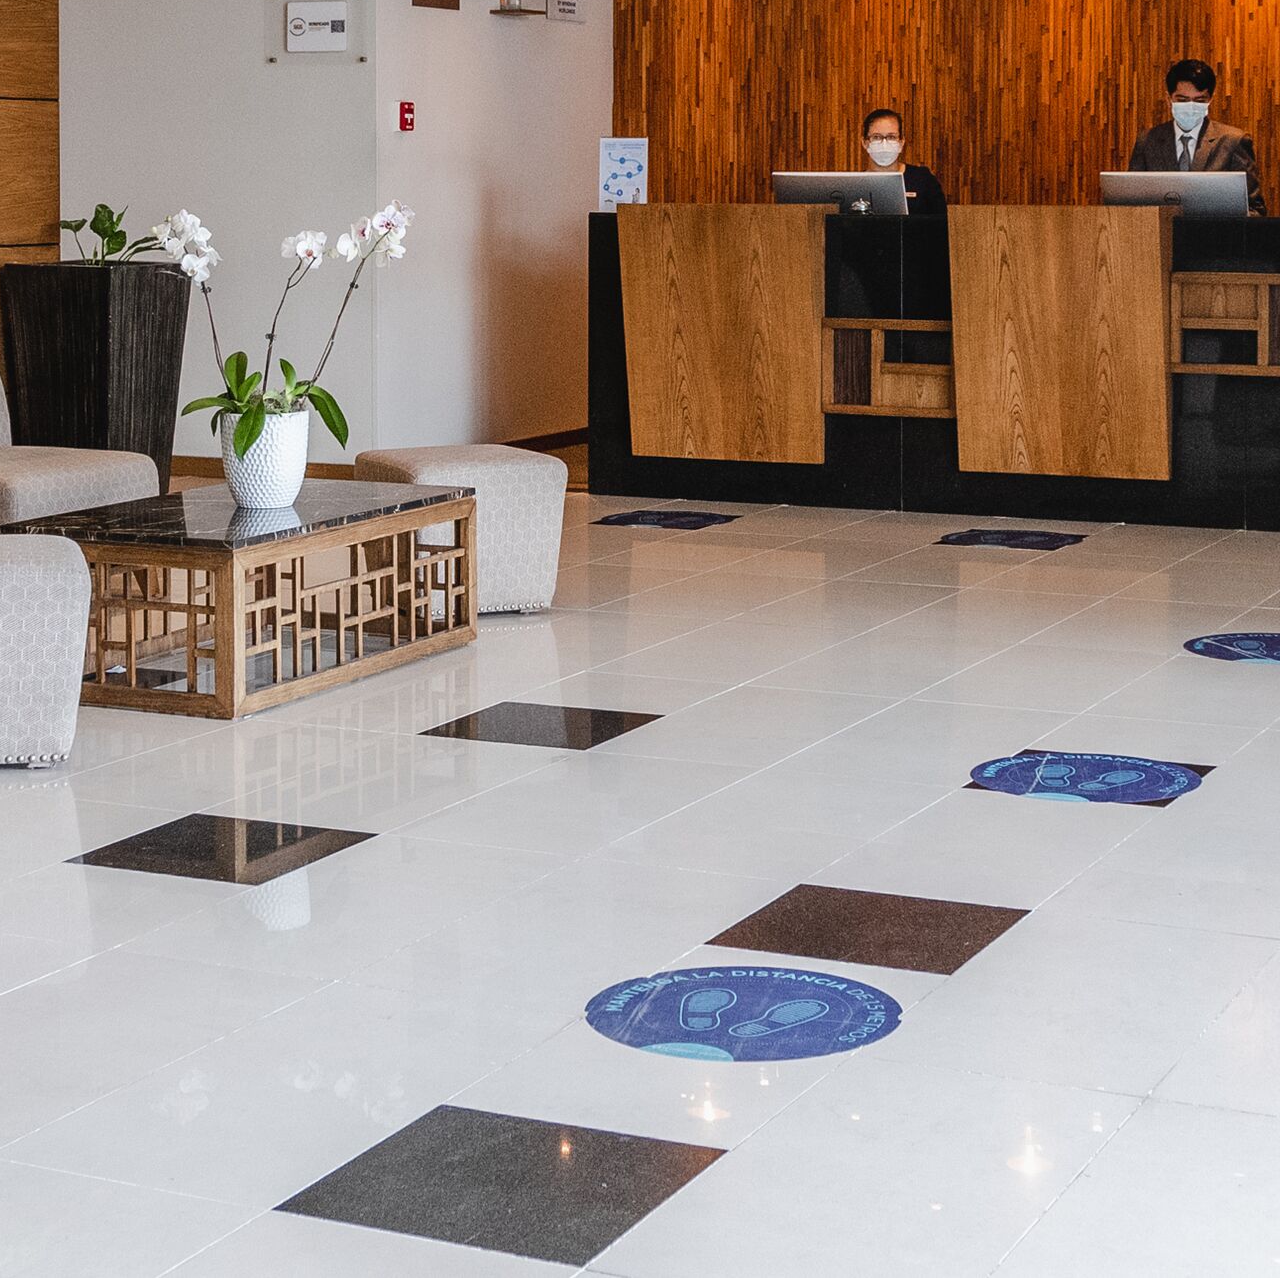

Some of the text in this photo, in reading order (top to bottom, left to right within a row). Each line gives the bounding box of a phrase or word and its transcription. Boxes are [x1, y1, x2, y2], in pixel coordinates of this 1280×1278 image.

[692, 970, 724, 979] LA
[731, 970, 848, 992] DISTANCIA
[605, 974, 689, 1012] MANTENGA
[846, 988, 875, 1001] DE
[838, 1010, 887, 1043] METROS
